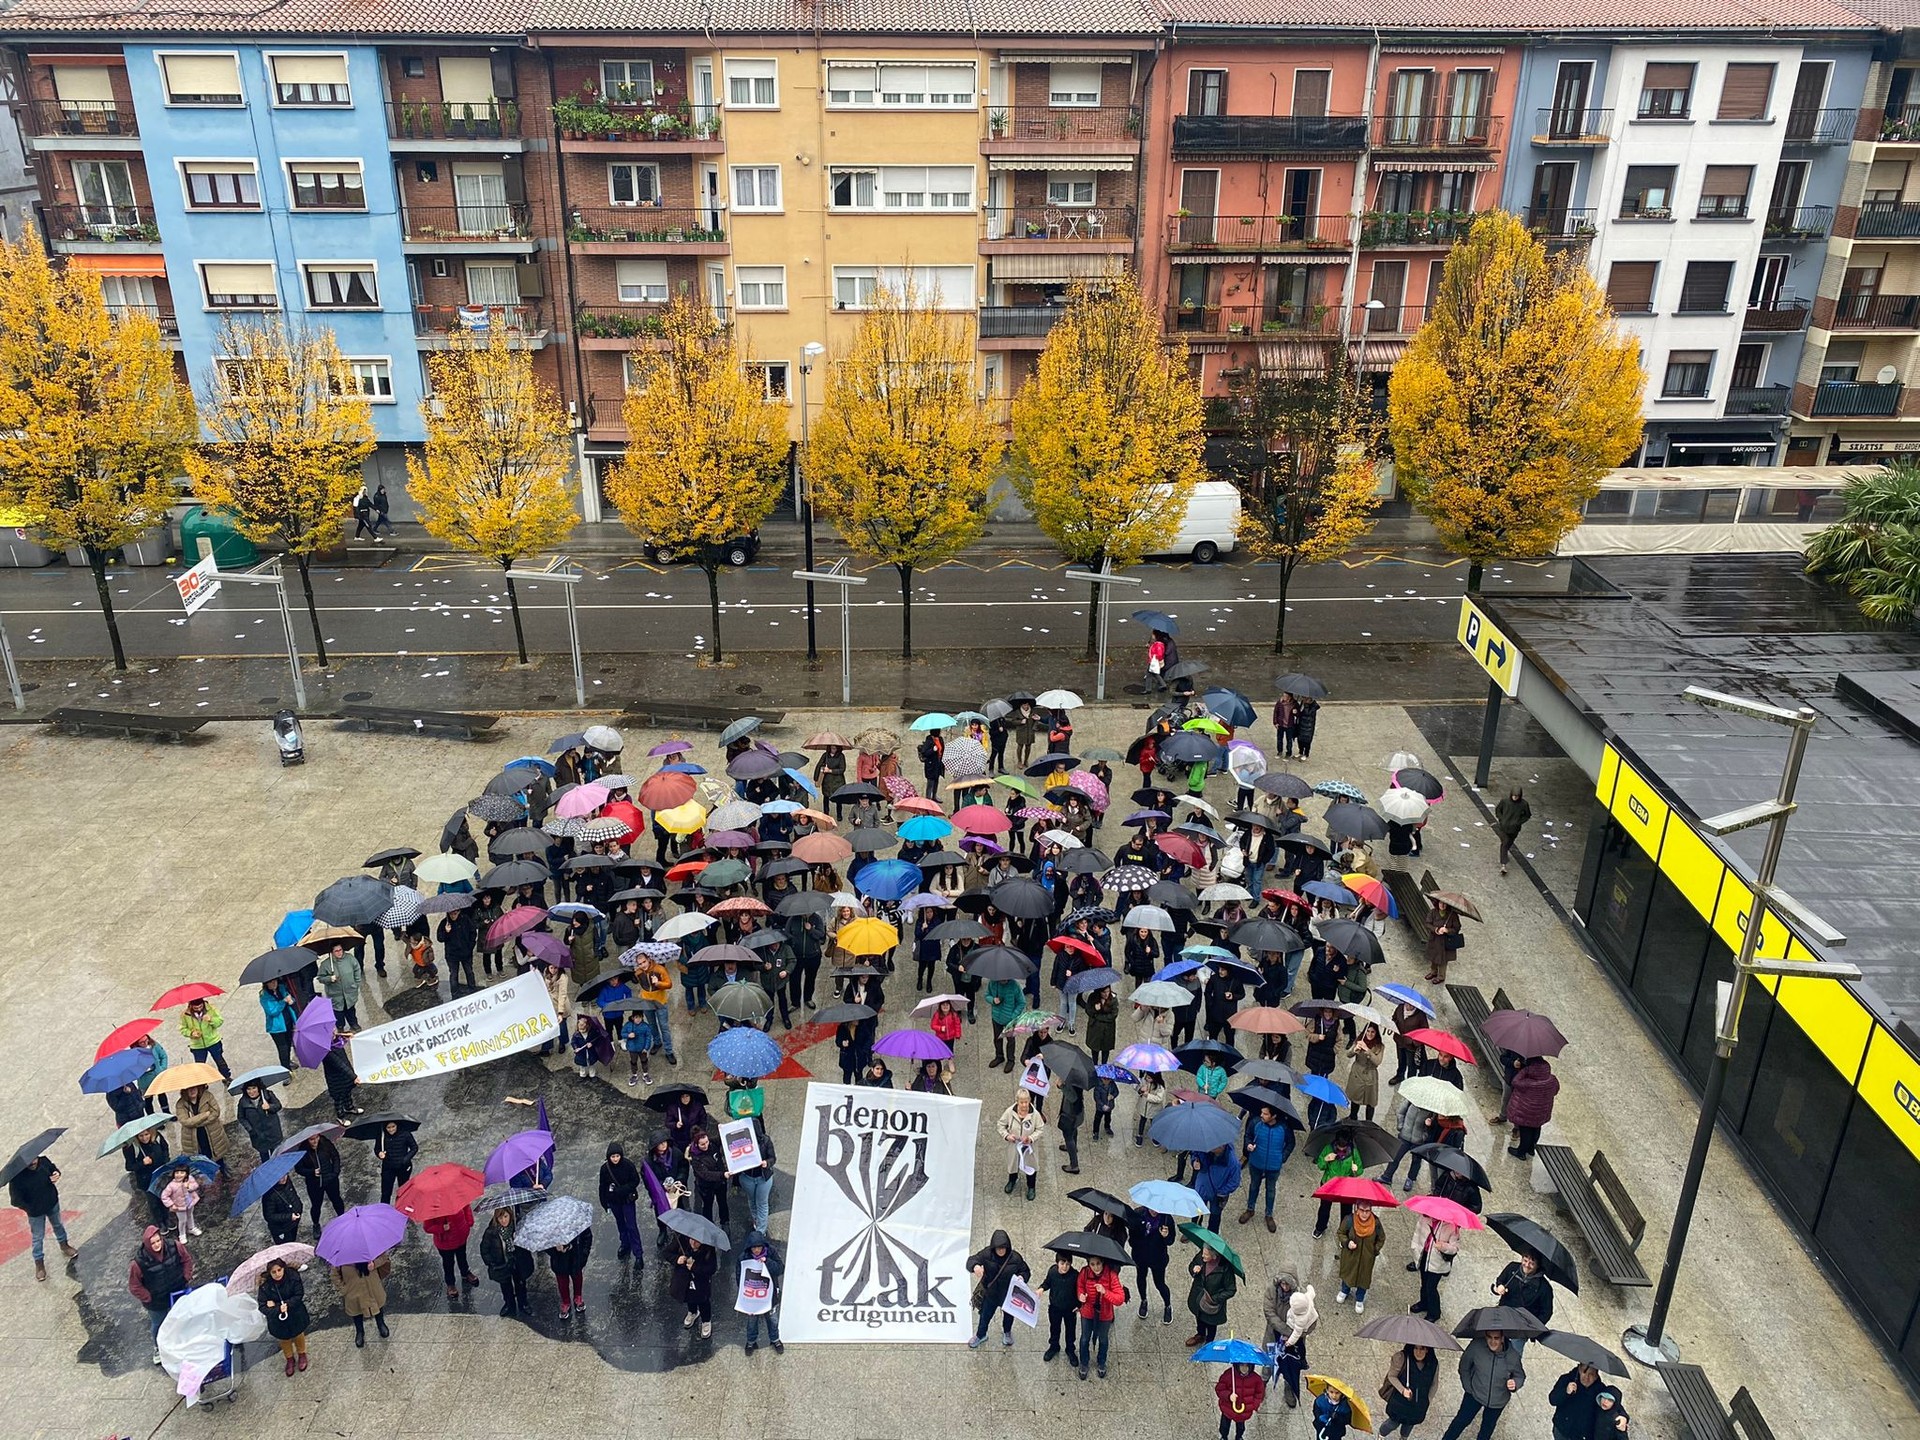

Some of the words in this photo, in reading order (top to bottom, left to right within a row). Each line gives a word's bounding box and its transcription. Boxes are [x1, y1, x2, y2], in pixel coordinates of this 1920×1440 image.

[179, 572, 200, 598] 30
[1468, 617, 1479, 640] P
[381, 1021, 423, 1046] KALEAK
[424, 999, 492, 1030] LEHERTZEKO,
[435, 1012, 553, 1067] FEMINISTARA
[833, 1095, 928, 1134] denon
[1908, 1100, 1920, 1119] B
[743, 1288, 767, 1298] 30
[817, 1303, 957, 1329] erdigunean
